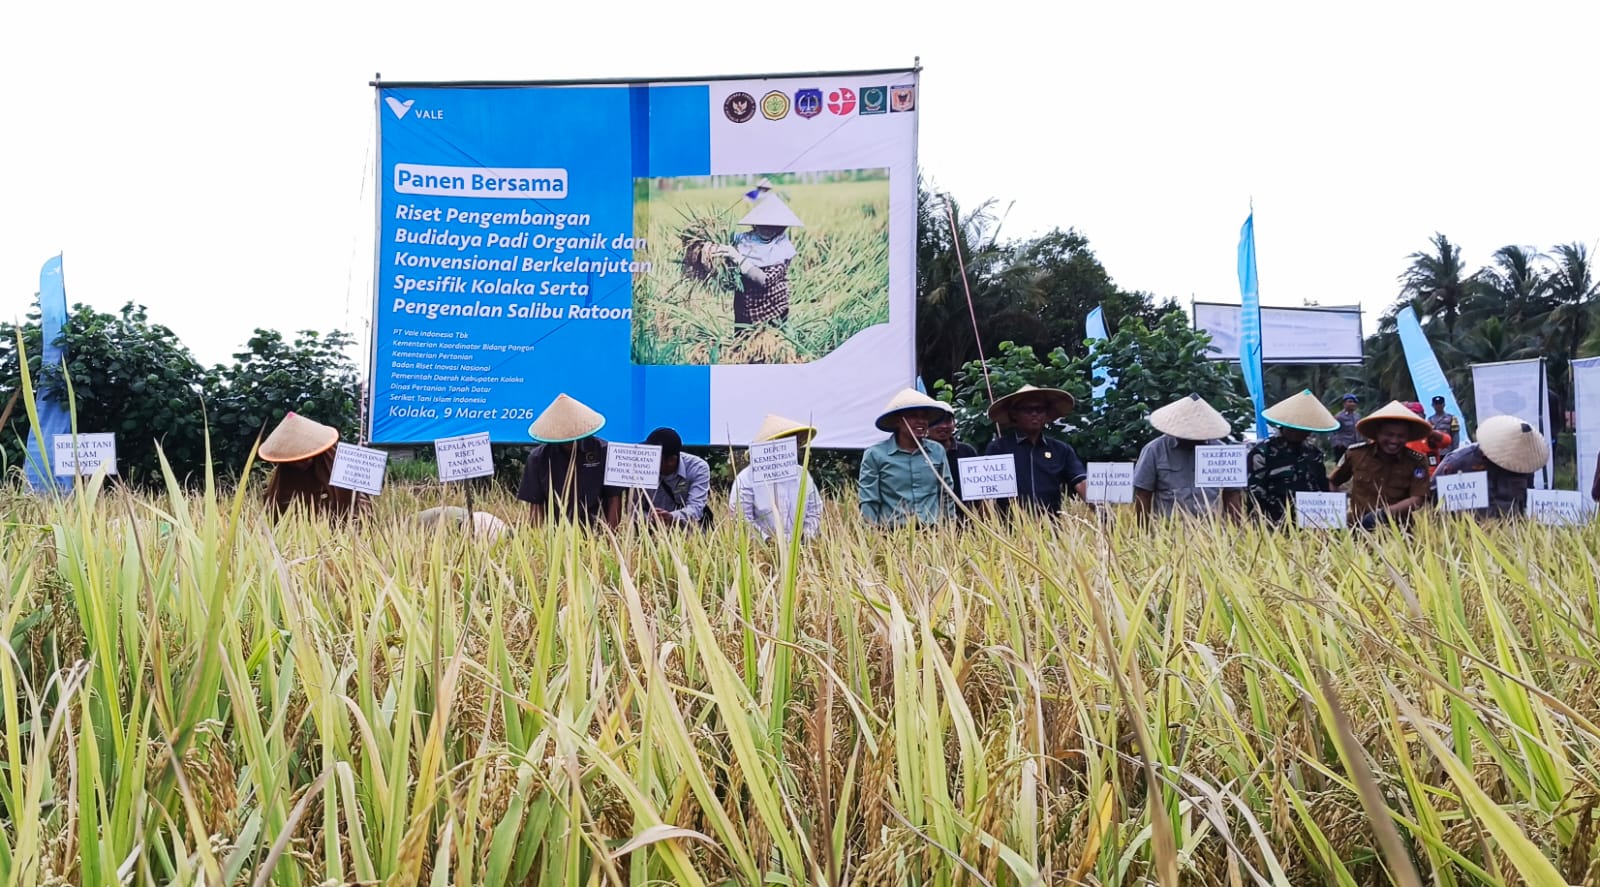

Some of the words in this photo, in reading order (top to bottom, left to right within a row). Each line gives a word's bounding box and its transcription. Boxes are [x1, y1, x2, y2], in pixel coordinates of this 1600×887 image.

[416, 110, 444, 120] VALE
[398, 170, 464, 190] Panen
[472, 174, 564, 192] Bersama
[395, 204, 442, 222] Riset
[446, 208, 590, 230] Pengembangan
[394, 228, 482, 250] Budidaya
[486, 232, 528, 249] Padi
[532, 234, 608, 253] Organik
[612, 234, 648, 250] dan
[394, 252, 518, 272] Konvensional
[522, 256, 652, 277] Berkelanjutan
[393, 275, 466, 294] Spesifik
[471, 279, 535, 296] Kolaka
[540, 281, 590, 296] Serta
[392, 298, 502, 319] Pengenalan
[507, 302, 564, 318] Salibu
[568, 304, 632, 320] Ratoon
[392, 340, 438, 348] Kementerian
[482, 344, 507, 352] Bidang
[392, 351, 437, 359] Kementerian
[391, 372, 432, 381] Pemerintah
[460, 375, 499, 384] Kabupaten
[389, 406, 439, 419] Kolaka,
[444, 407, 452, 418] 9
[455, 408, 498, 419] Maret
[500, 408, 534, 419] 2026
[439, 442, 466, 451] KEPALA
[468, 439, 488, 447] PUSAT
[764, 445, 786, 453] DEPUTI
[455, 450, 474, 458] RISET
[448, 456, 484, 466] TANAMAN
[452, 466, 482, 474] PANGAN
[764, 470, 789, 479] PANGAN
[964, 474, 1014, 484] INDONESIA
[981, 485, 998, 493] TBK
[1447, 481, 1476, 491] CAMAT
